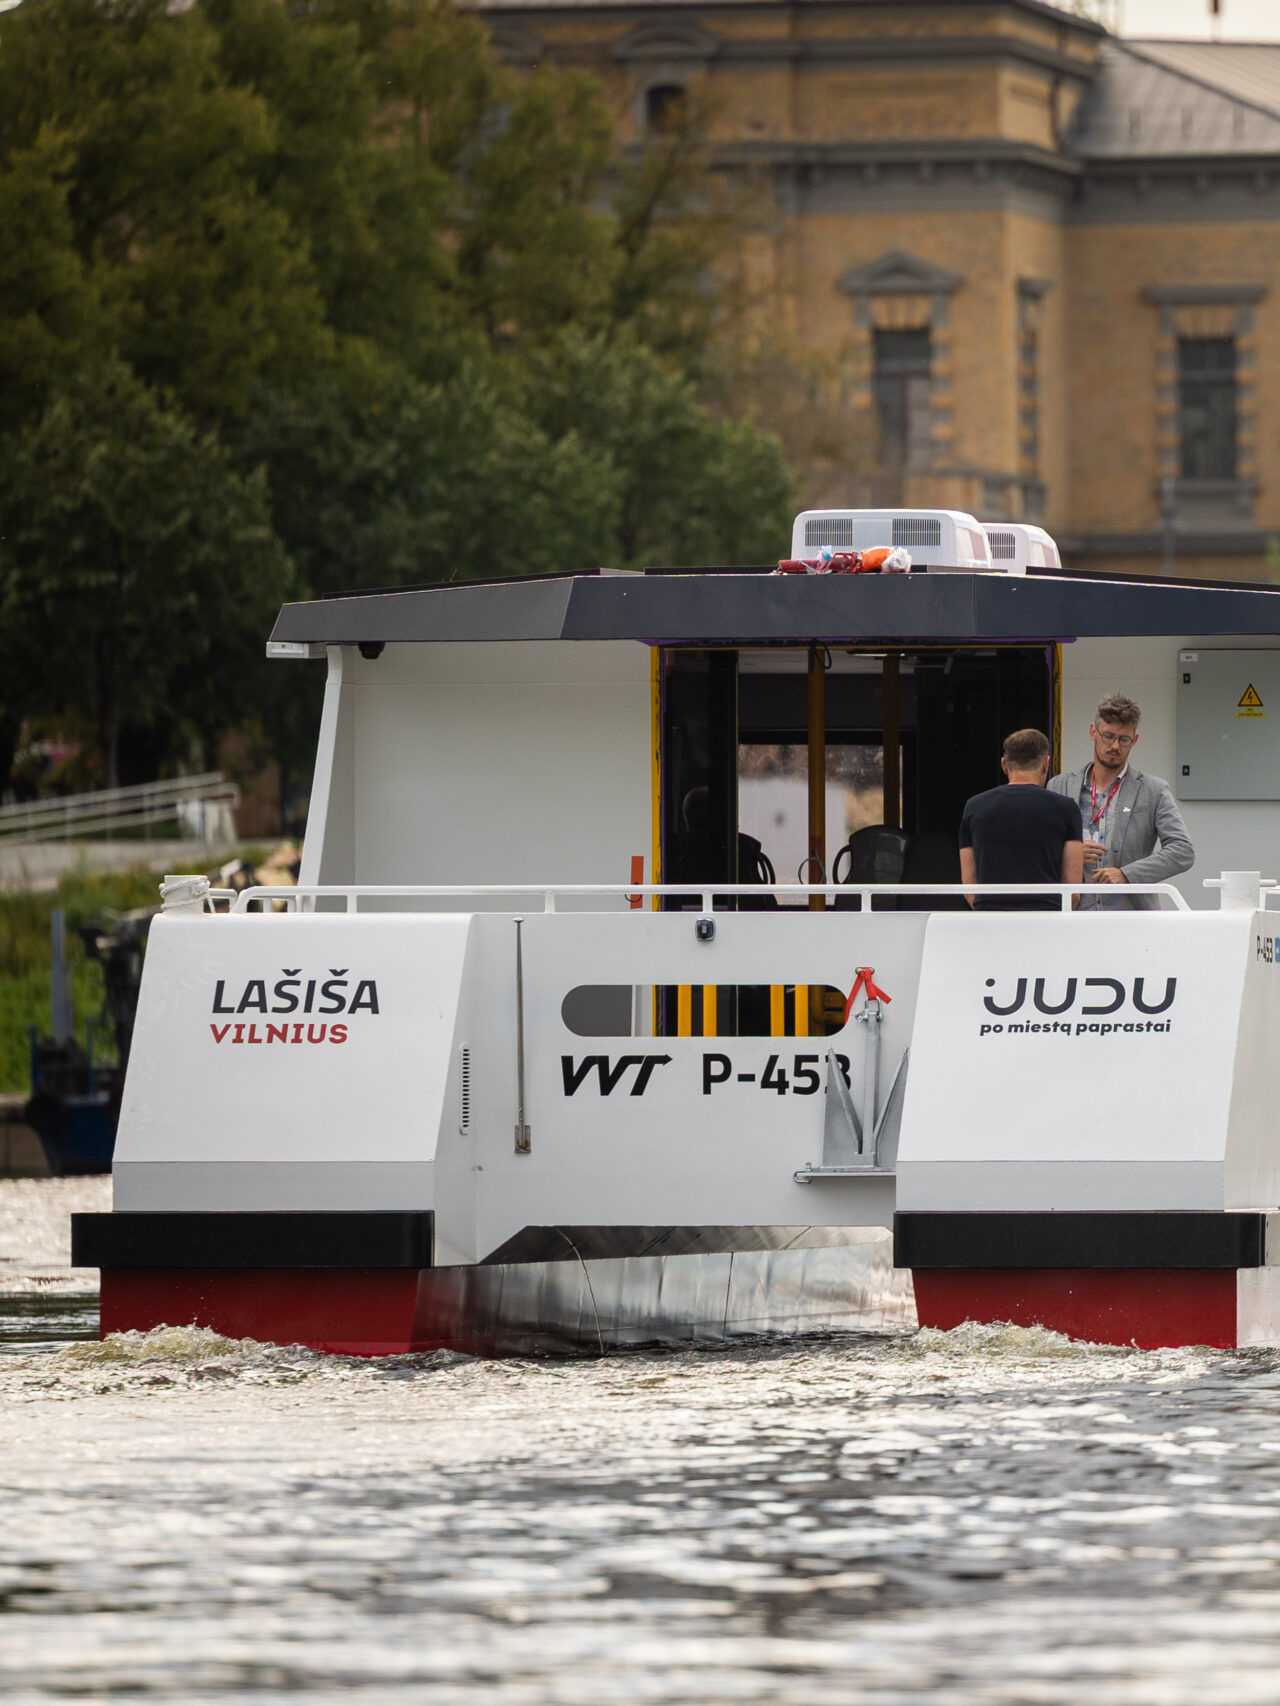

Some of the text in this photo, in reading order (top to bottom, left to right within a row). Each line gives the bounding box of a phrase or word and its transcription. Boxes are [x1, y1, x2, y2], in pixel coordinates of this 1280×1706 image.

[212, 969, 379, 1014] LAŠIŠA
[210, 1024, 348, 1044] VILNIUS
[980, 1019, 1171, 1036] po miestą paprastai
